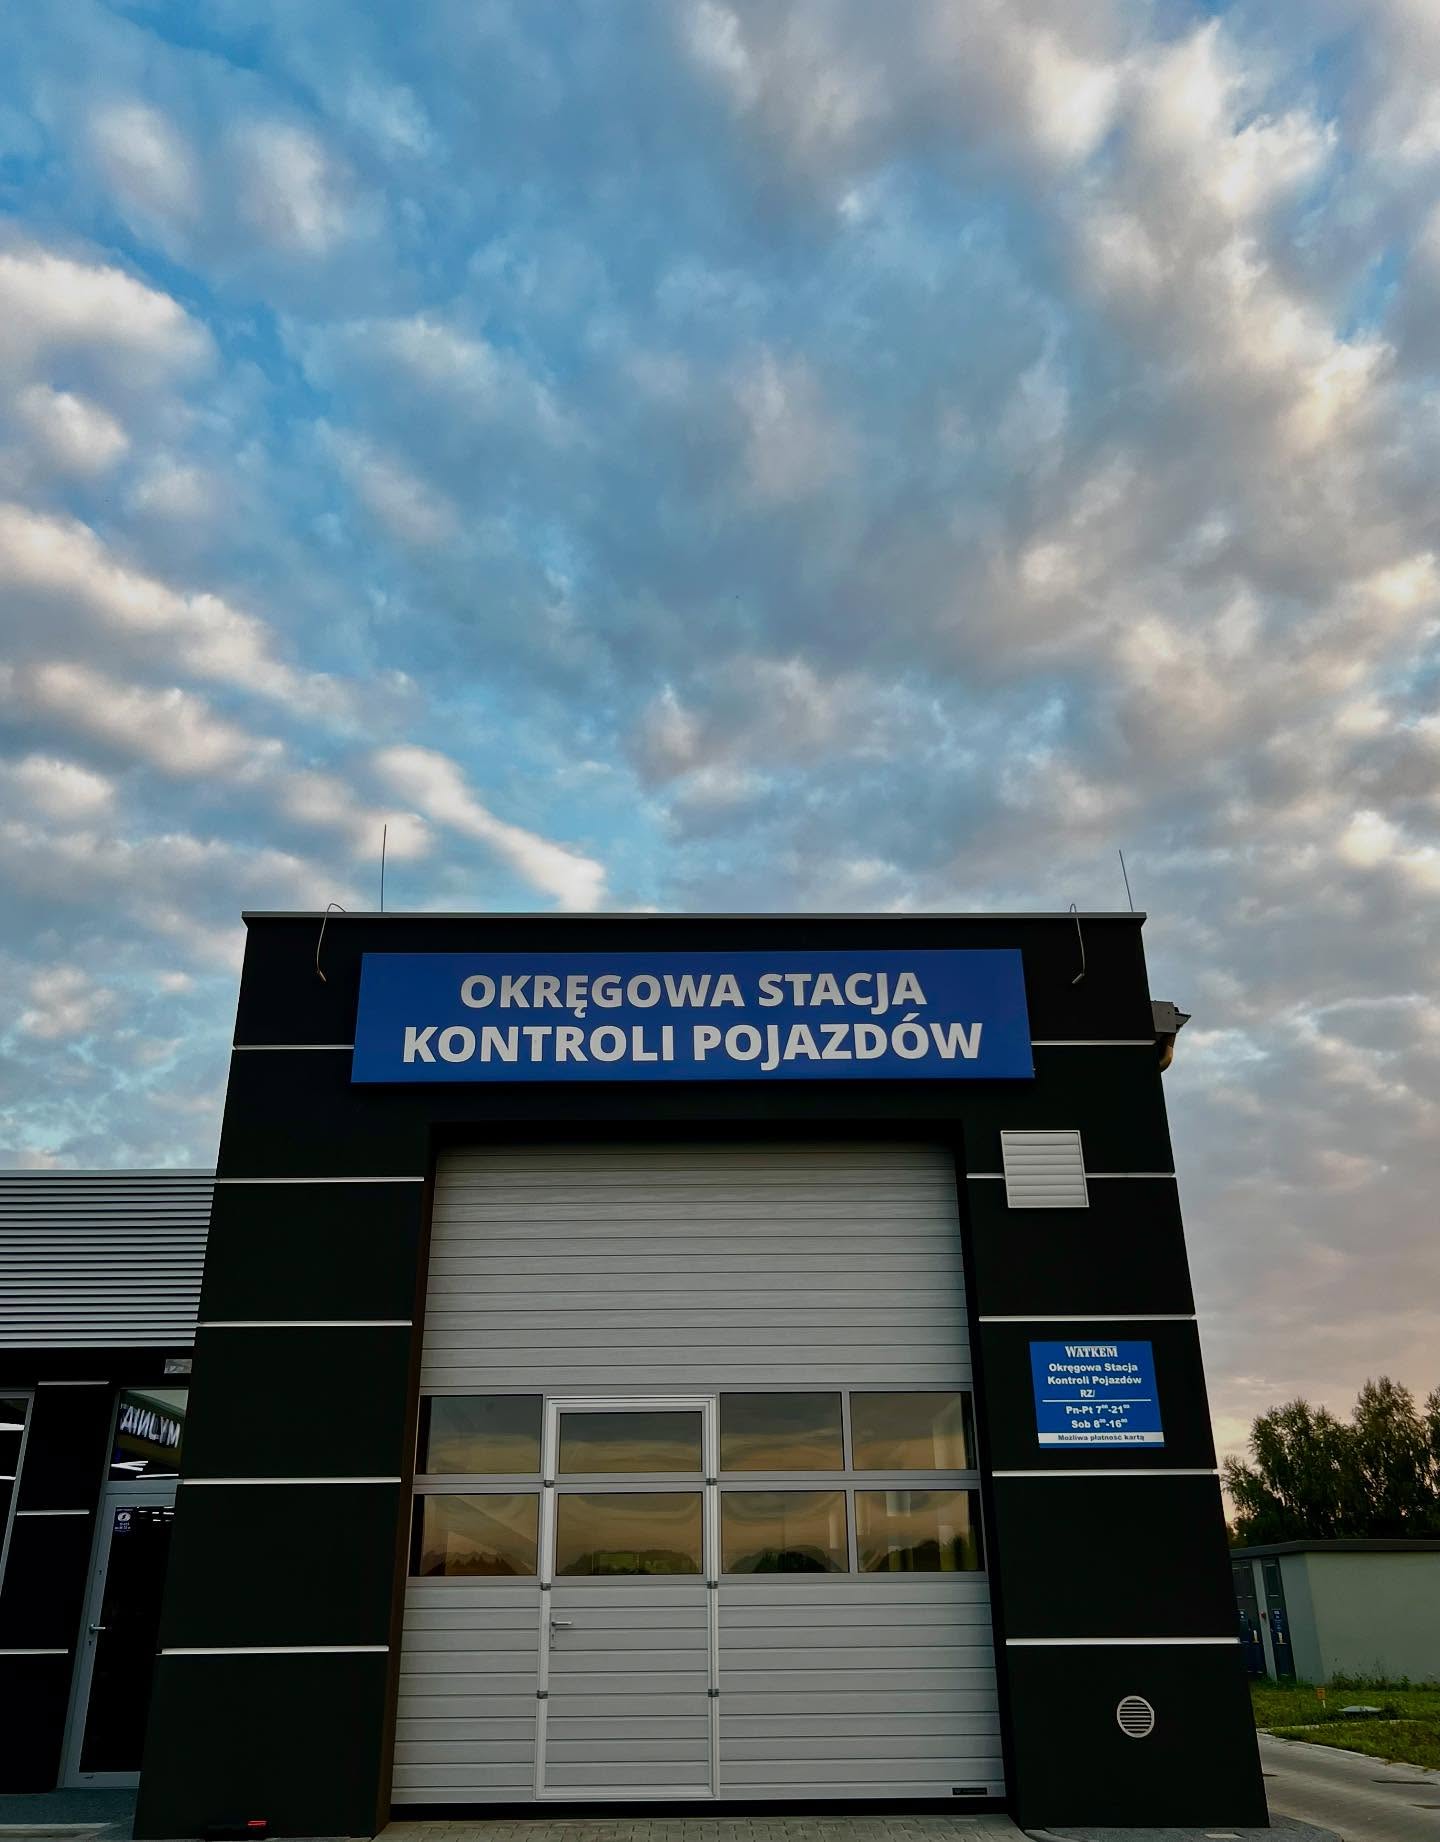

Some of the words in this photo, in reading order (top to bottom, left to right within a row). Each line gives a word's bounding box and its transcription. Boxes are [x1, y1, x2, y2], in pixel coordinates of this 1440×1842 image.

[460, 974, 744, 1017] OKRĘGOWA
[757, 972, 927, 1014] STACJA
[402, 1024, 674, 1063] KONTROLI
[693, 1013, 983, 1071] POJAZDÓW
[1065, 1346, 1118, 1357] WATKEM
[1049, 1364, 1101, 1373] Okręgowa
[1105, 1363, 1138, 1373] Stacja
[1092, 1376, 1142, 1385] Pojazdów
[1066, 1406, 1093, 1414] Pn-Pt
[1072, 1420, 1091, 1428] Sob
